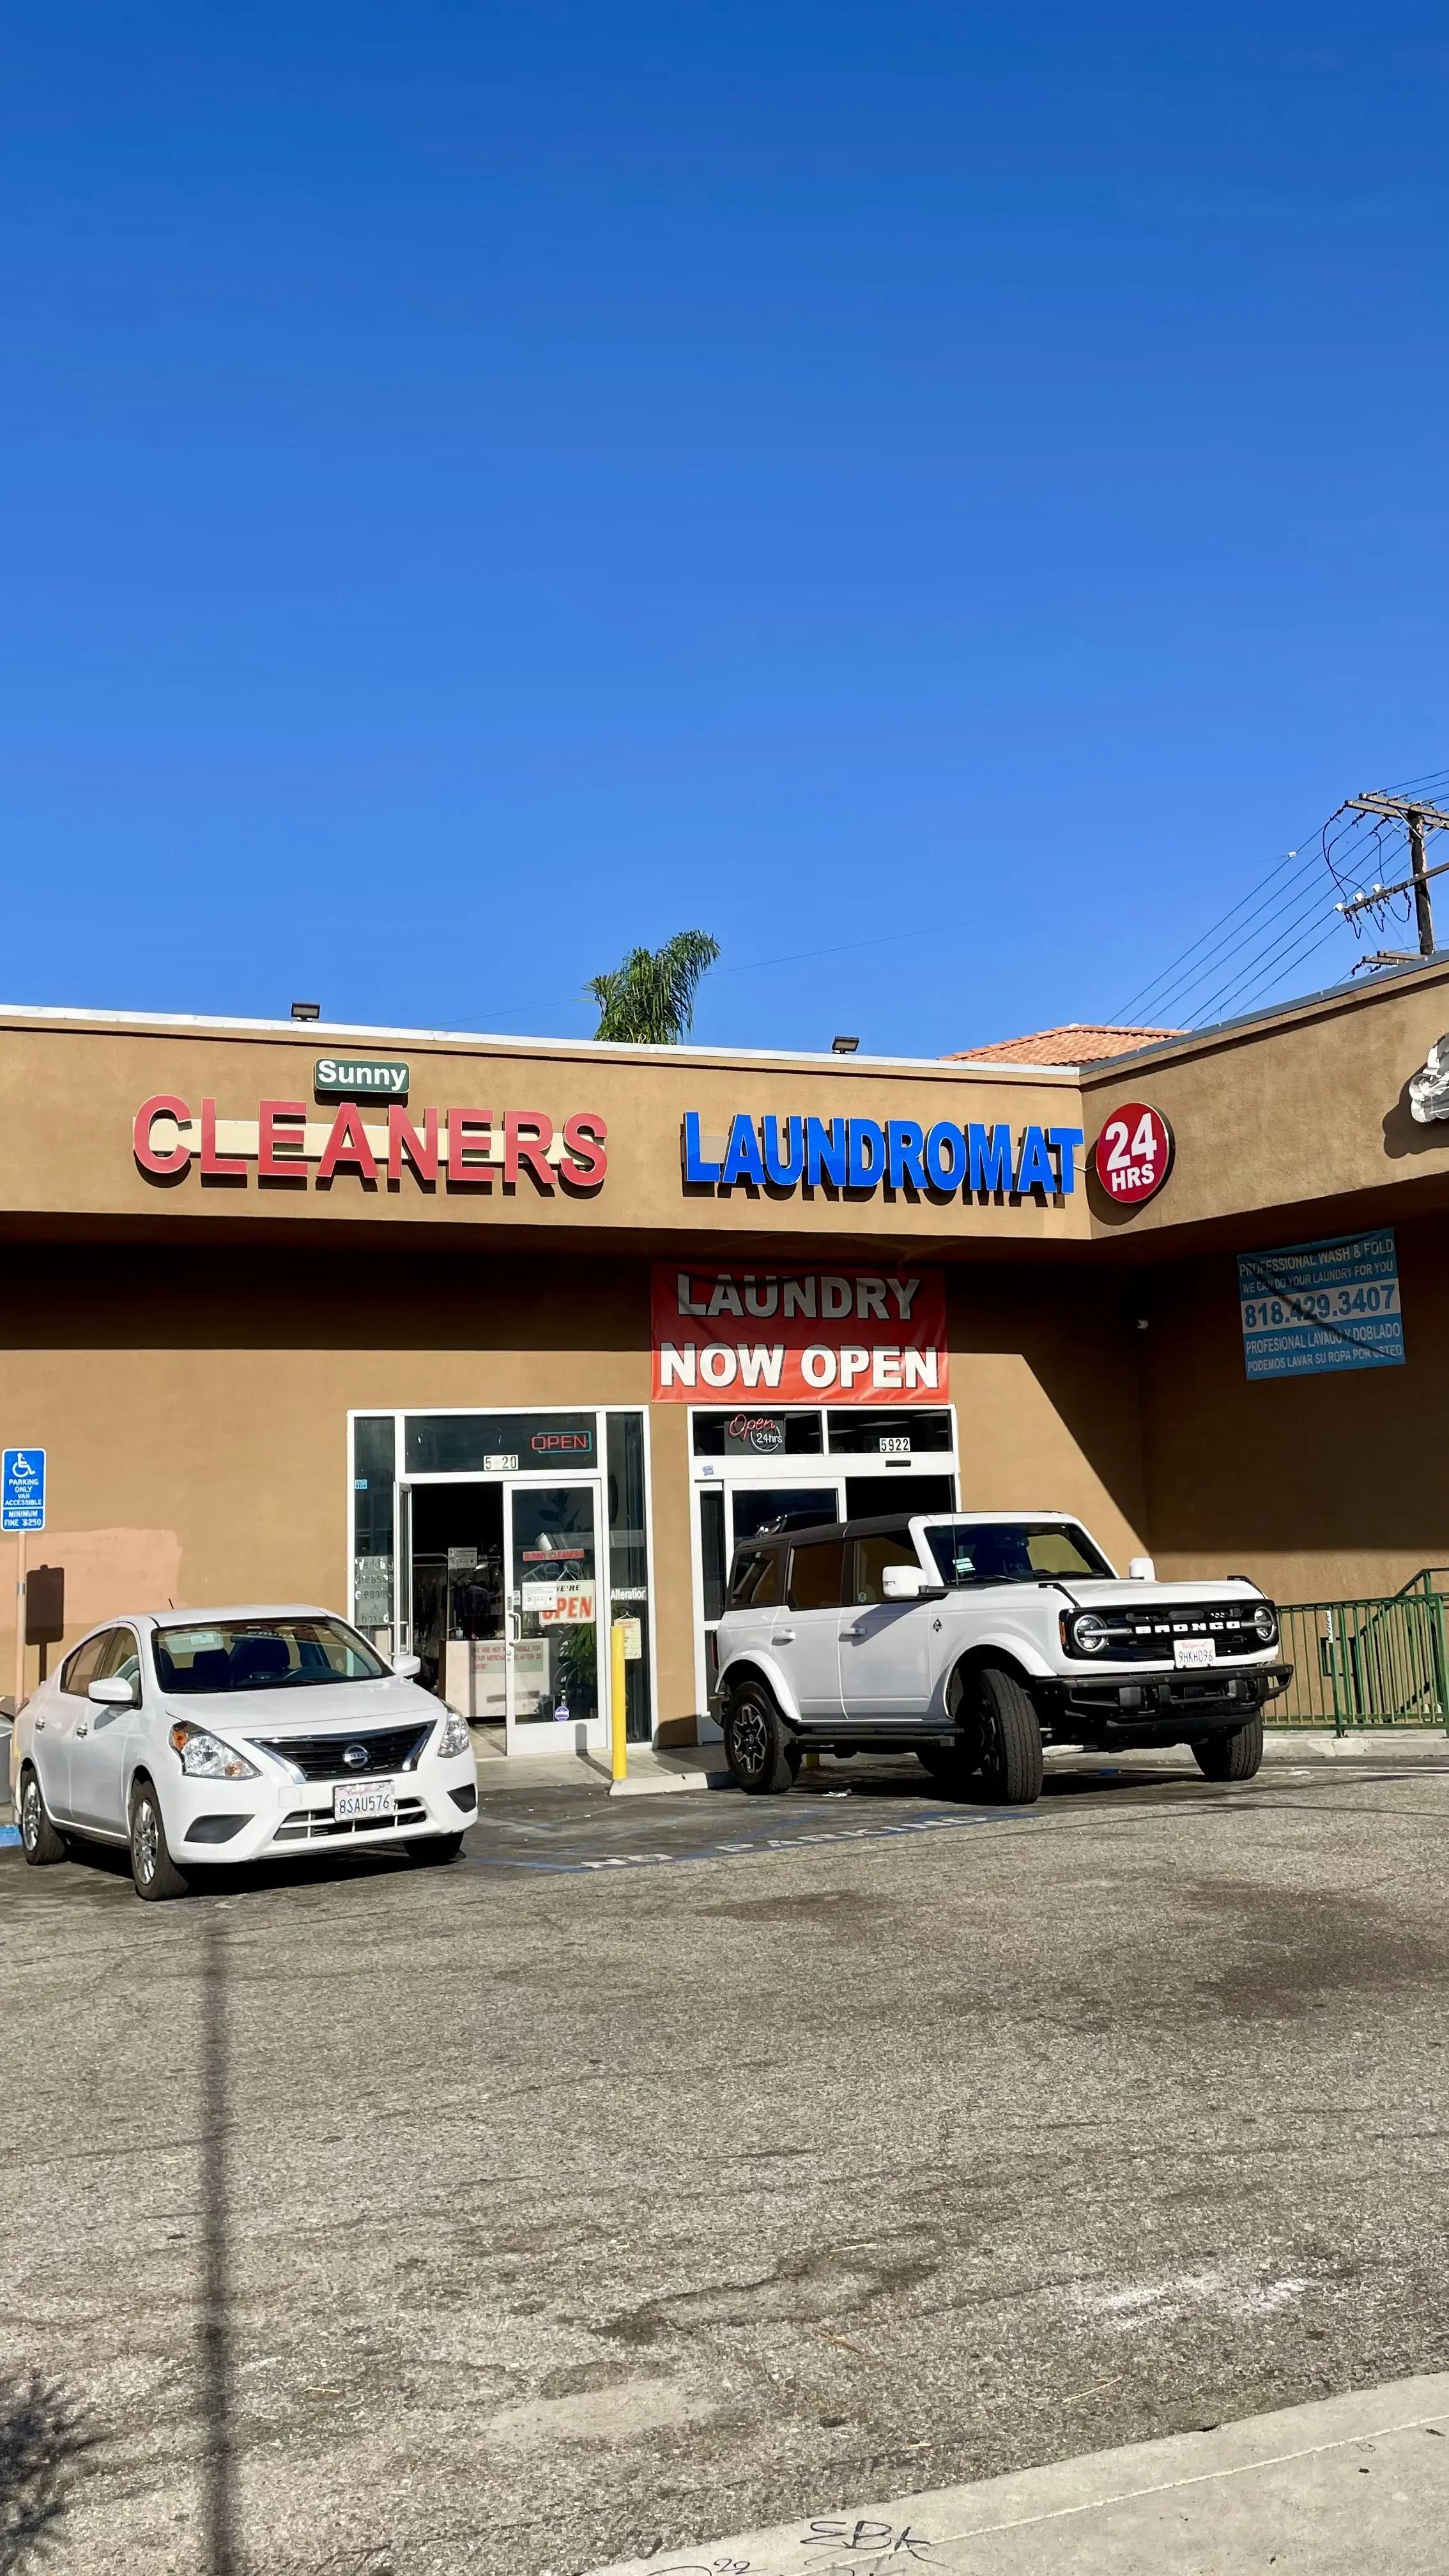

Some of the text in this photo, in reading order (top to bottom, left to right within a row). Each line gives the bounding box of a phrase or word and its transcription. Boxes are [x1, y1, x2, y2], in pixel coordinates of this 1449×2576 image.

[318, 1059, 407, 1091] Sunny
[133, 1094, 608, 1186] CLEANERS
[685, 1110, 1084, 1195] LAUNDROMAT
[1105, 1113, 1157, 1172] 24
[1112, 1163, 1155, 1193] HRS
[1239, 1238, 1394, 1276] PROFESSIONAL WASH & FOLD
[1242, 1281, 1255, 1294] WE
[1275, 1277, 1286, 1289] DO
[1287, 1274, 1311, 1287] YOUR
[1312, 1267, 1352, 1284] LAUNDRY
[1354, 1263, 1373, 1276] FOR
[1374, 1260, 1393, 1273] YOU
[676, 1273, 921, 1321] LAUNDRY
[1244, 1284, 1395, 1328] 818.429.3407
[1246, 1321, 1400, 1355] PROFESIONAL LAVADO Y DOBLADO
[659, 1342, 939, 1390] NOW OPEN
[1248, 1344, 1402, 1373] PODEMOS LAVAR SU ROPA POR USTED
[730, 1414, 776, 1439] Open
[756, 1432, 783, 1443] 24hrs
[532, 1435, 587, 1450] OPEN
[880, 1438, 910, 1451] 5922
[485, 1455, 517, 1469] 520
[22, 1518, 42, 1526] $250
[1135, 1621, 1241, 1634] BRONCO
[1178, 1649, 1213, 1664] 9HKH096
[339, 1794, 390, 1814] 8SAU576
[580, 1817, 988, 1869] NO PARKING
